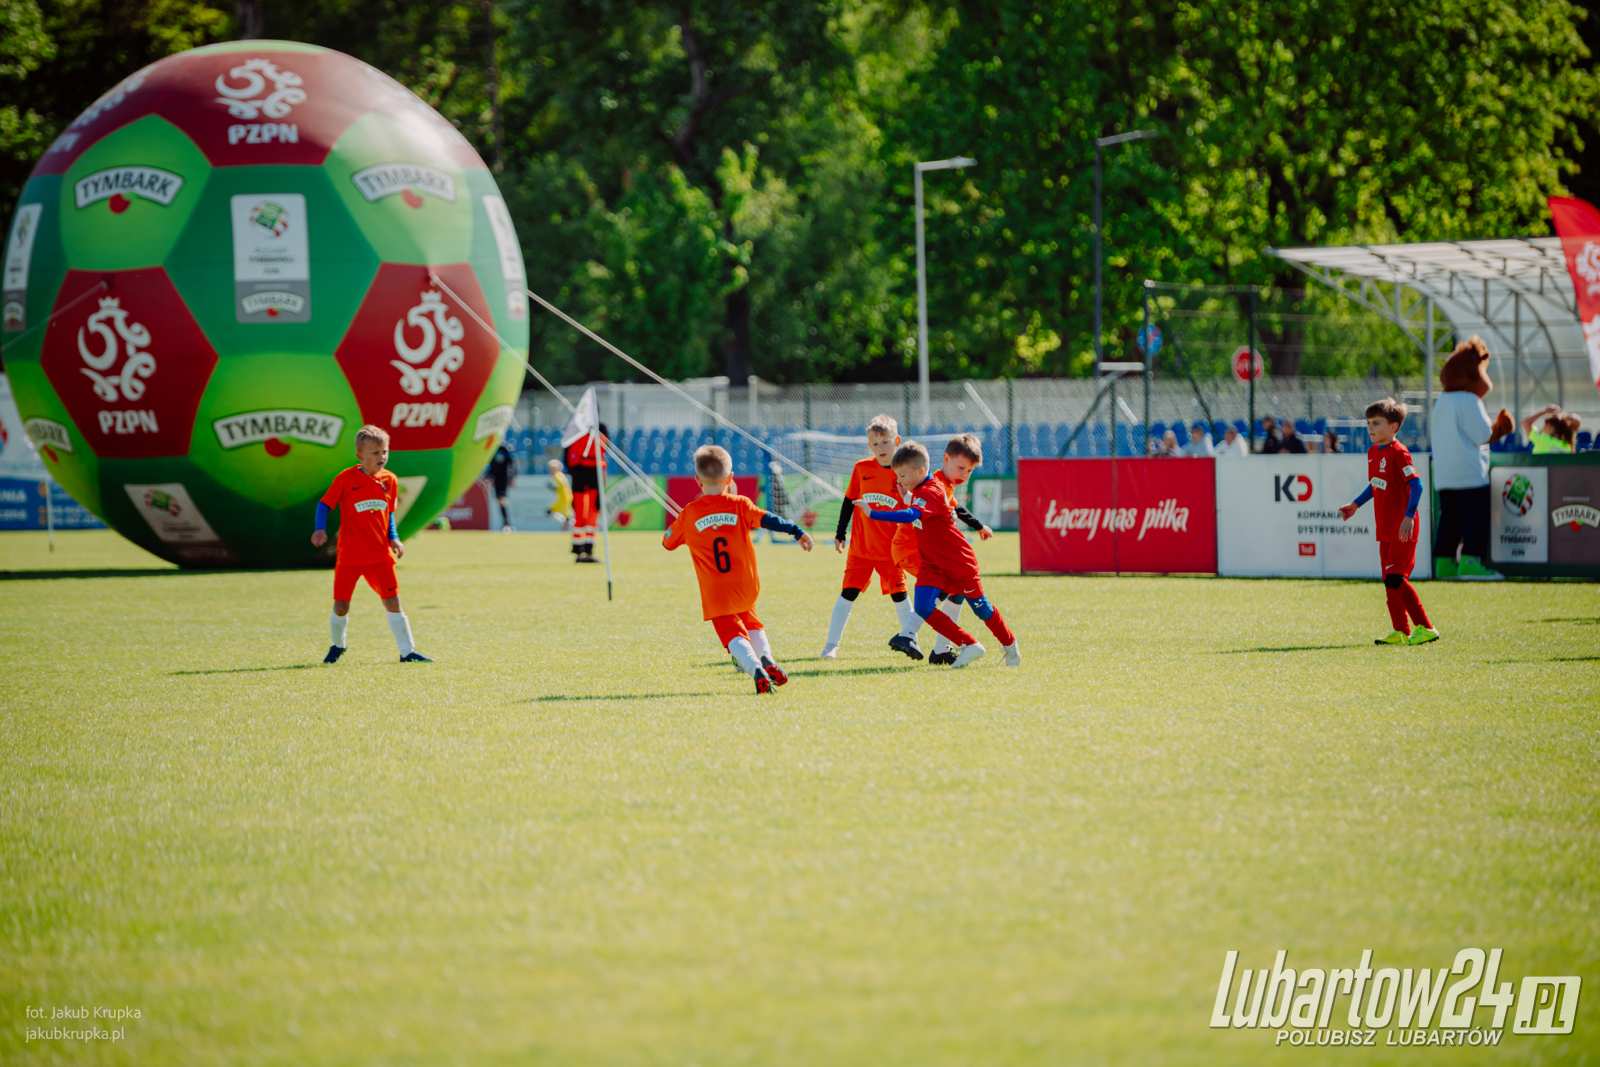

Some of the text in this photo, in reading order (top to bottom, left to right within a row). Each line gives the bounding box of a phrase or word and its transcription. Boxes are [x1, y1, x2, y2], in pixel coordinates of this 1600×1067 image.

[228, 122, 298, 145] PZPN
[81, 171, 176, 199] TYMBARK
[98, 409, 159, 434] PZPN
[391, 402, 449, 427] PZPN
[222, 414, 334, 441] TYMBARK
[697, 515, 736, 529] TYMBARK
[1044, 498, 1189, 542] Łączy nas piłka
[1554, 507, 1597, 523] TYMBARK
[1297, 525, 1370, 535] DYSTRYBUCYJNA
[713, 537, 731, 573] 6
